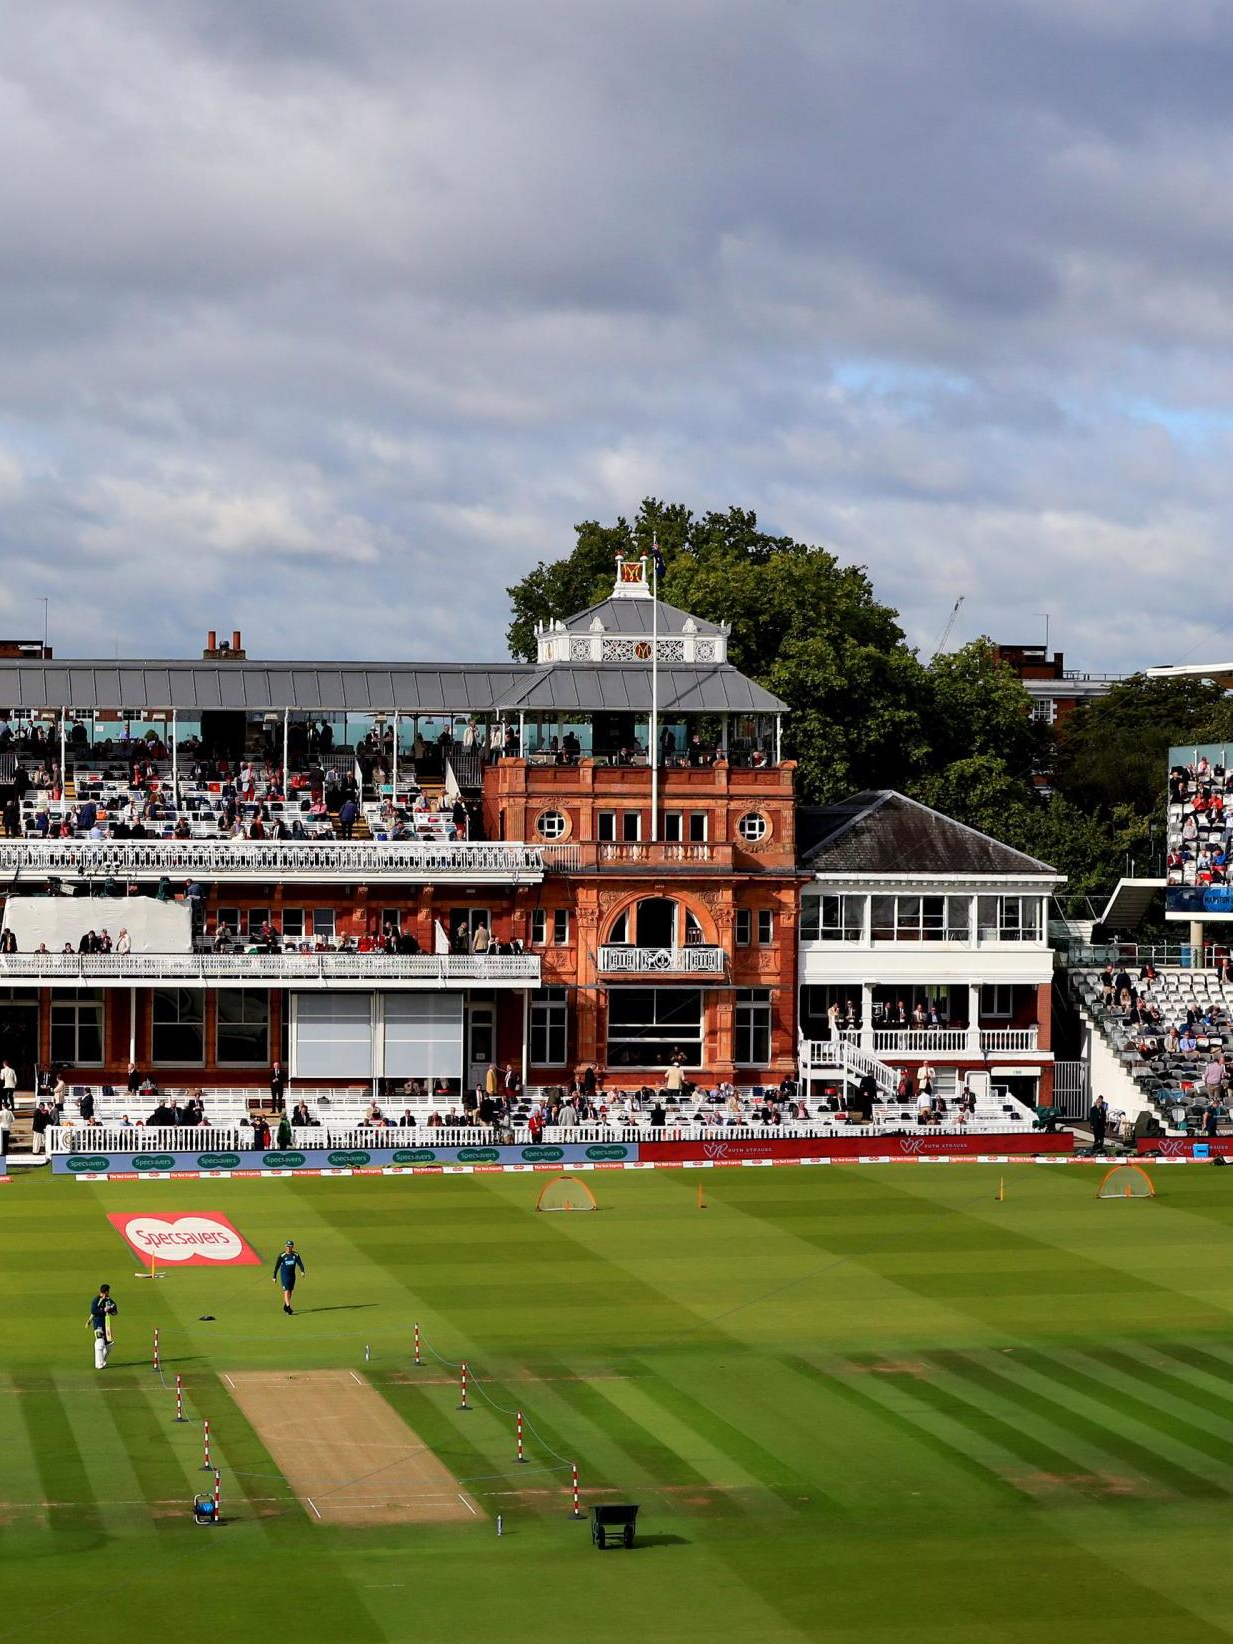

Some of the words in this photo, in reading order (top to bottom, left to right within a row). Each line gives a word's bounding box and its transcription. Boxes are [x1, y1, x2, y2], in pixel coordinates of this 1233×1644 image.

[396, 1153, 431, 1162] Specsavers
[460, 1152, 496, 1161] Specsavers
[524, 1150, 560, 1159] Specsavers
[589, 1149, 624, 1157] Specsavers
[135, 1159, 171, 1168] Specsavers
[201, 1158, 237, 1166] Specsavers
[266, 1156, 302, 1165] Specsavers
[331, 1155, 367, 1163] Specsavers
[69, 1160, 106, 1169] Specsavers
[136, 1230, 230, 1248] Specsavers
